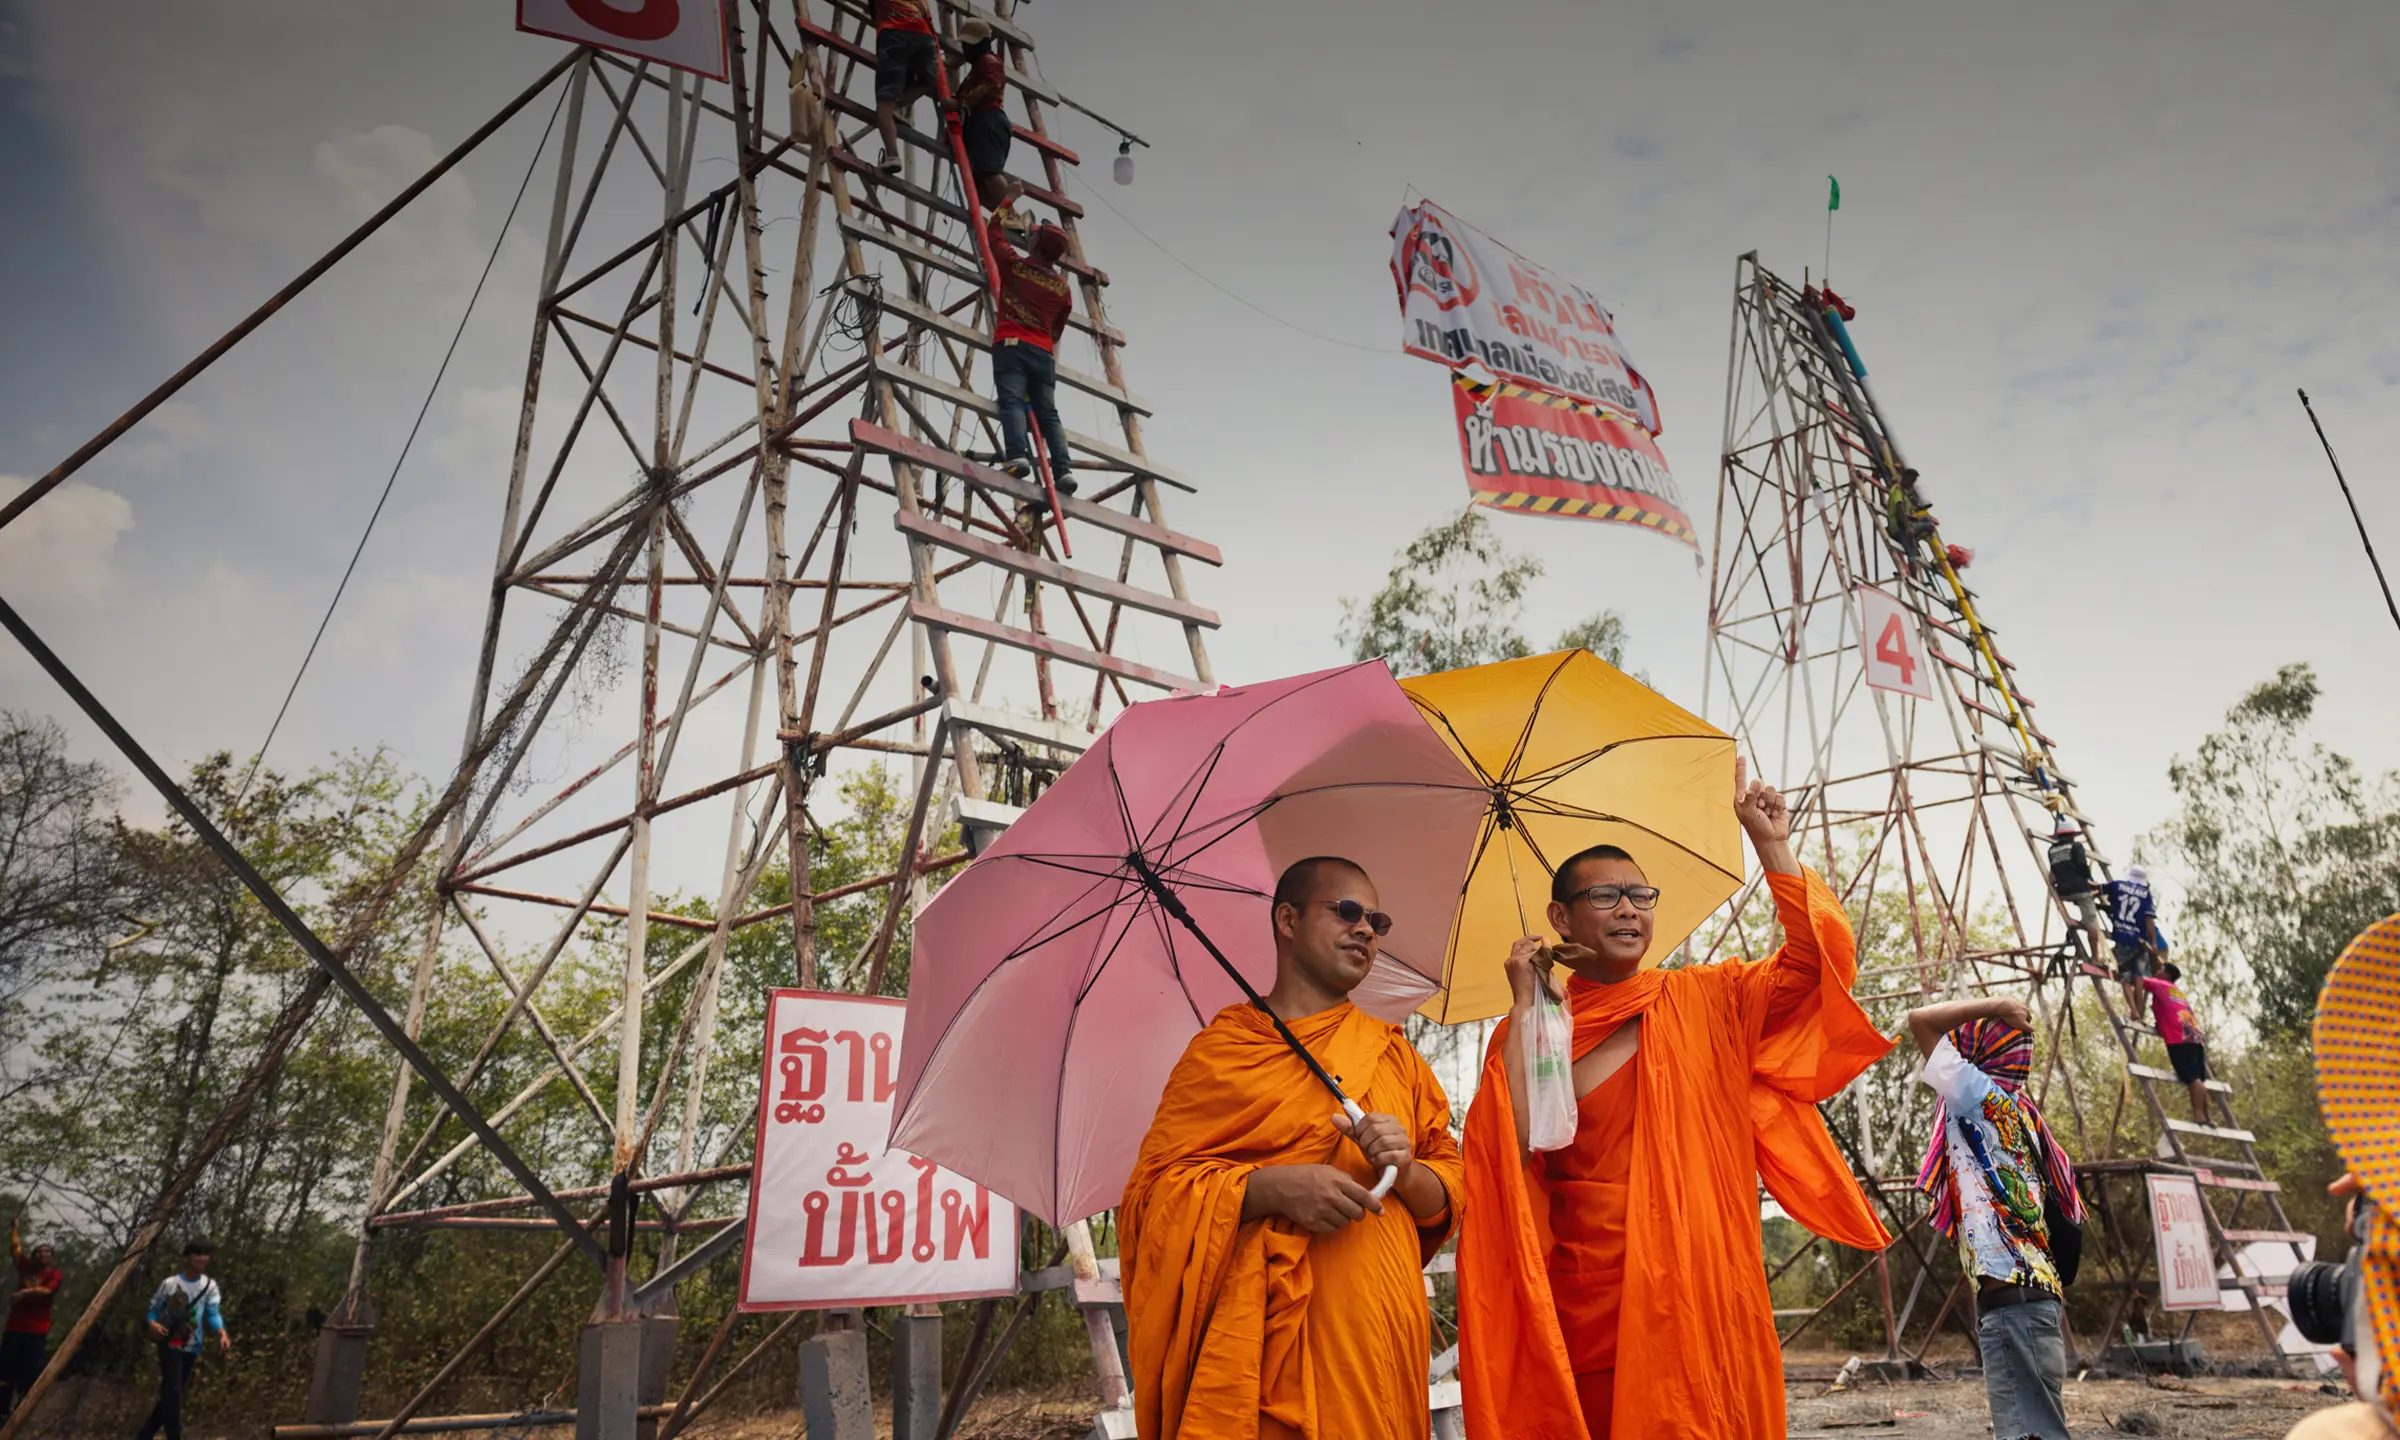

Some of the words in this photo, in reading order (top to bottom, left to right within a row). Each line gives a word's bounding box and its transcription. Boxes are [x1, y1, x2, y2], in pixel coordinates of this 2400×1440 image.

[1876, 612, 1916, 686] 4
[2118, 894, 2141, 925] 12
[775, 1027, 897, 1124] ฐาน
[798, 1142, 989, 1267] บั้งไฟ
